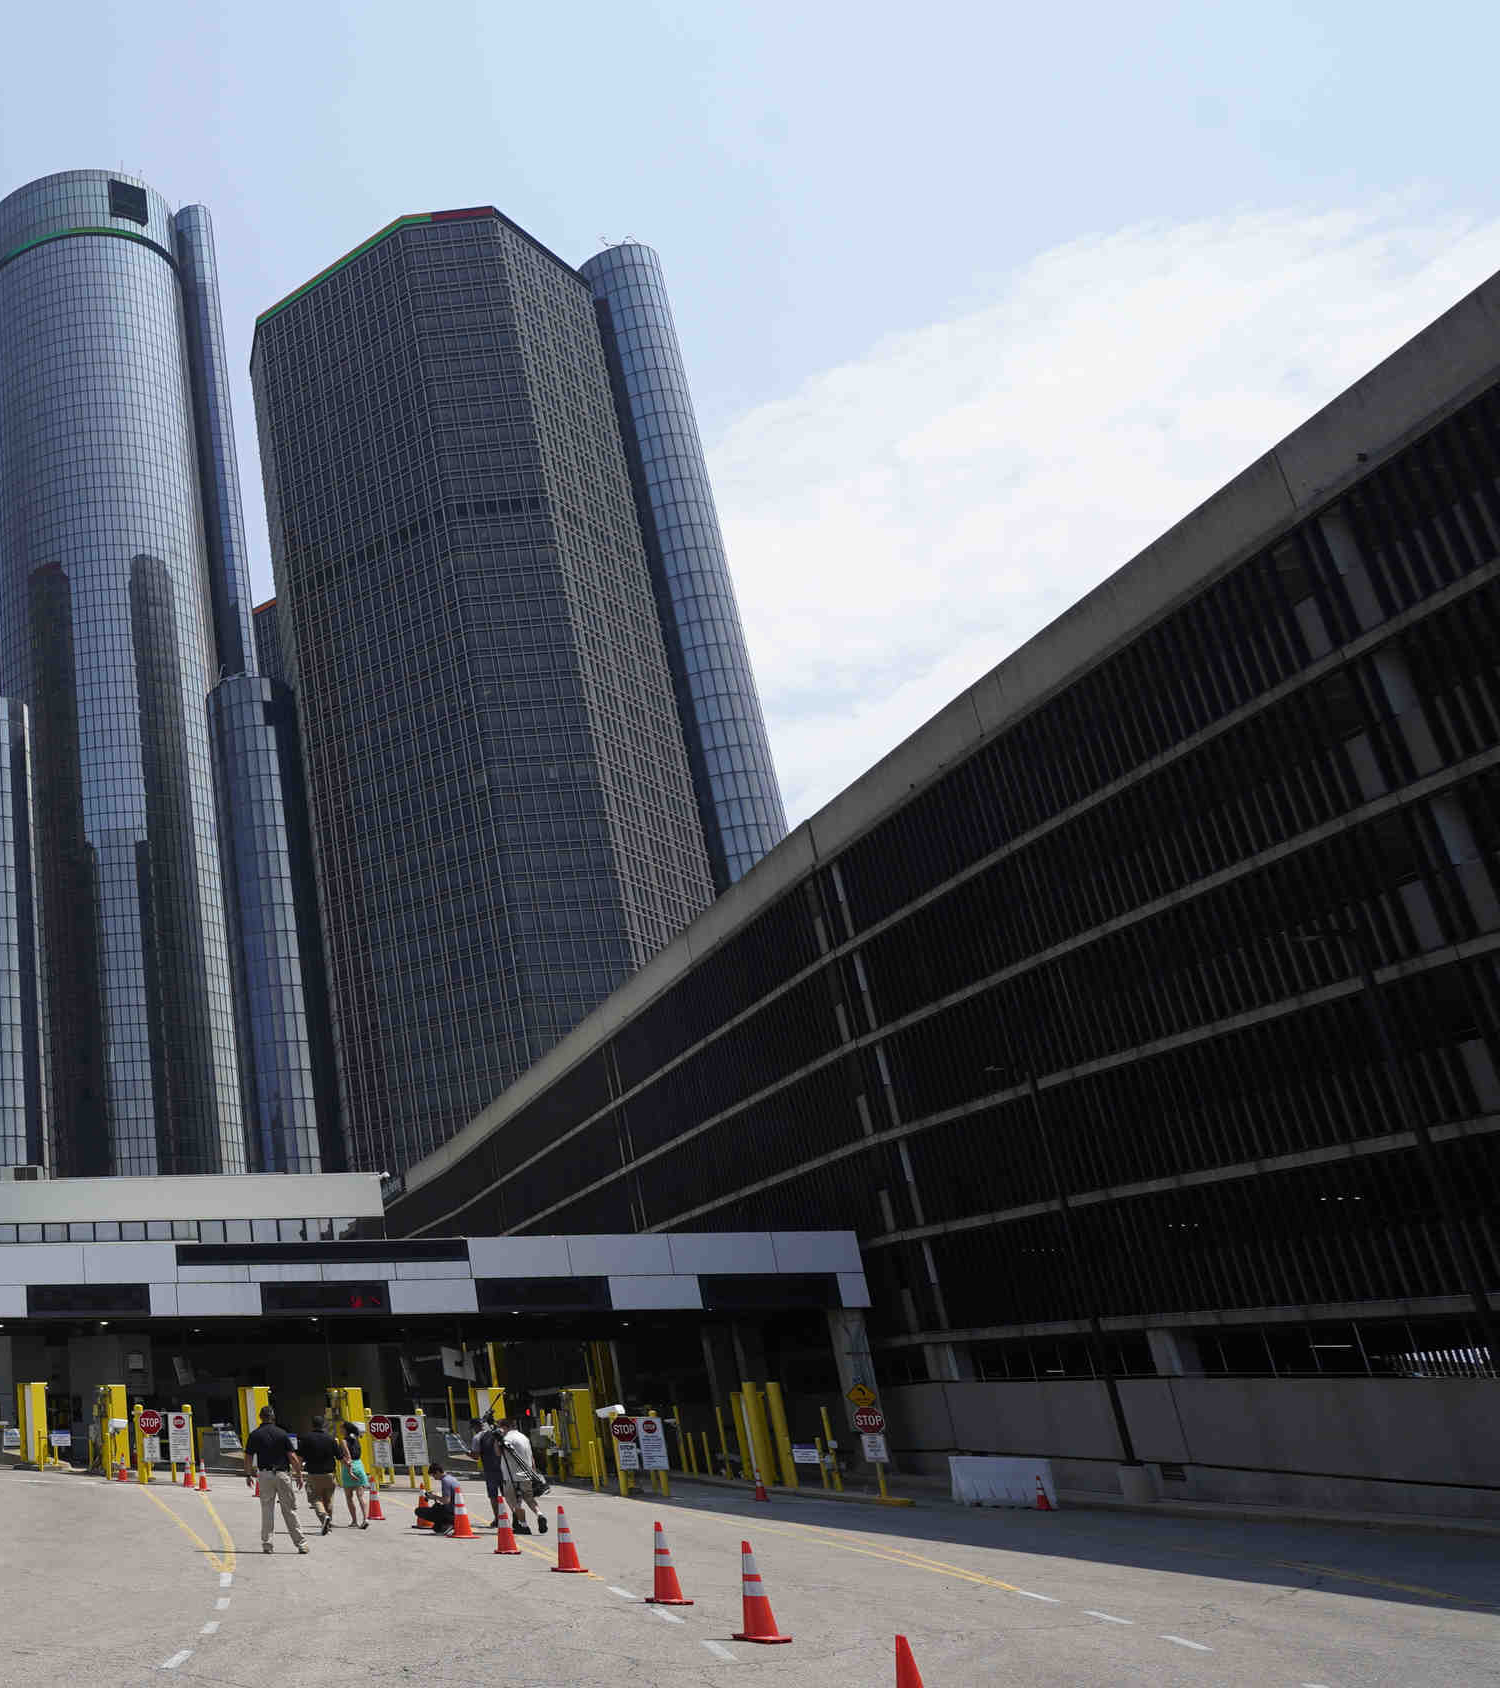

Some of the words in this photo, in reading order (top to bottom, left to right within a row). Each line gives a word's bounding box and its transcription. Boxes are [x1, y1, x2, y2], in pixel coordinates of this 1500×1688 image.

[140, 1417, 160, 1428] STOP
[855, 1415, 881, 1426] STOP
[370, 1422, 390, 1433] STOP
[613, 1423, 635, 1434] STOP
